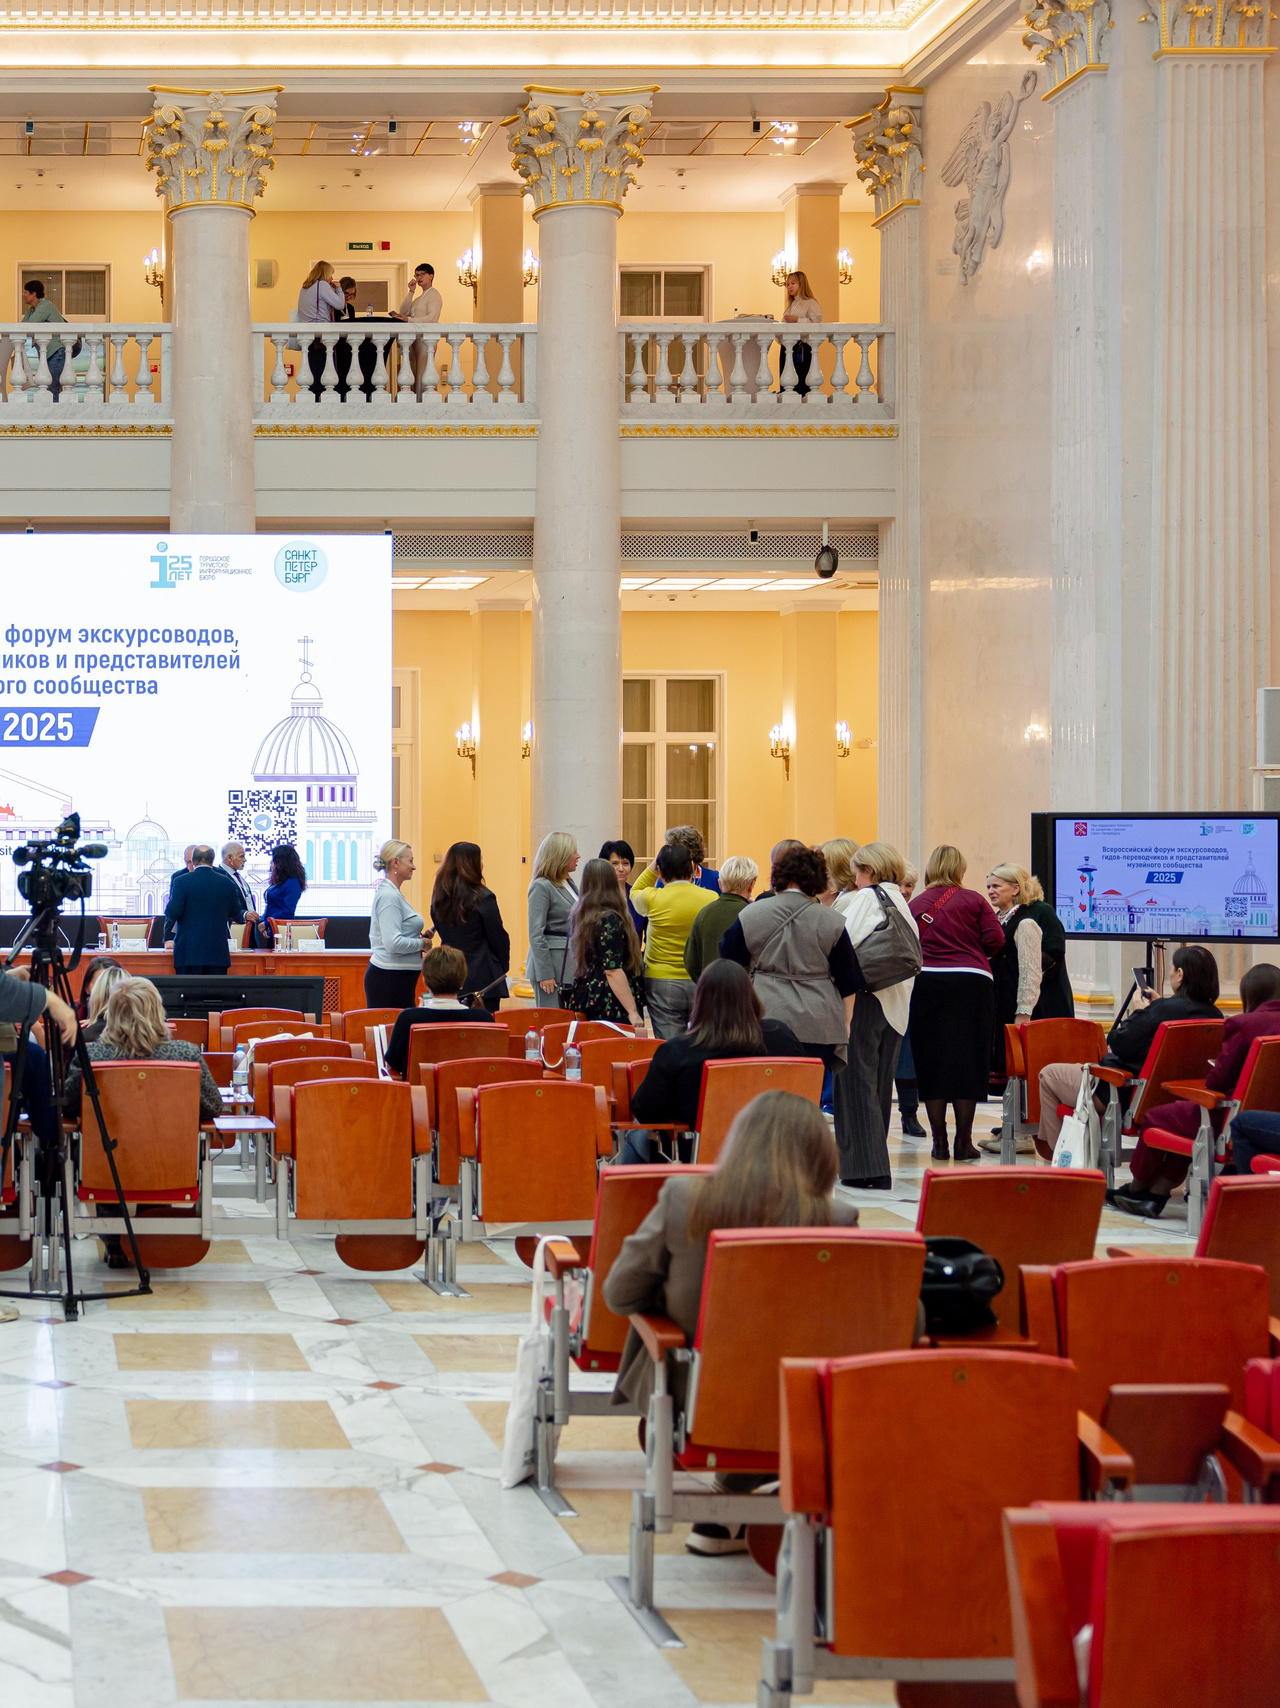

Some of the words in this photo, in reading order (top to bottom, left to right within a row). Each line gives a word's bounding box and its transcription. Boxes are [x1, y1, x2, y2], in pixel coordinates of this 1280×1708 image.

[199, 555, 231, 563] ГОРОДСКОЕ
[284, 549, 318, 561] САНКТ
[168, 555, 193, 571] 25
[284, 561, 318, 573] ПЕТЕР
[168, 571, 193, 581] ЛЕТ
[284, 573, 311, 584] БУРГ
[4, 623, 72, 648] форум
[77, 628, 239, 648] экскурсоводов,
[56, 653, 68, 669] и
[74, 649, 240, 674] представителей
[33, 674, 158, 697] сообщества
[3, 712, 74, 742] 2025
[1102, 846, 1153, 854] Всероссийский
[1153, 846, 1176, 854] форум
[1153, 872, 1176, 882] 2025
